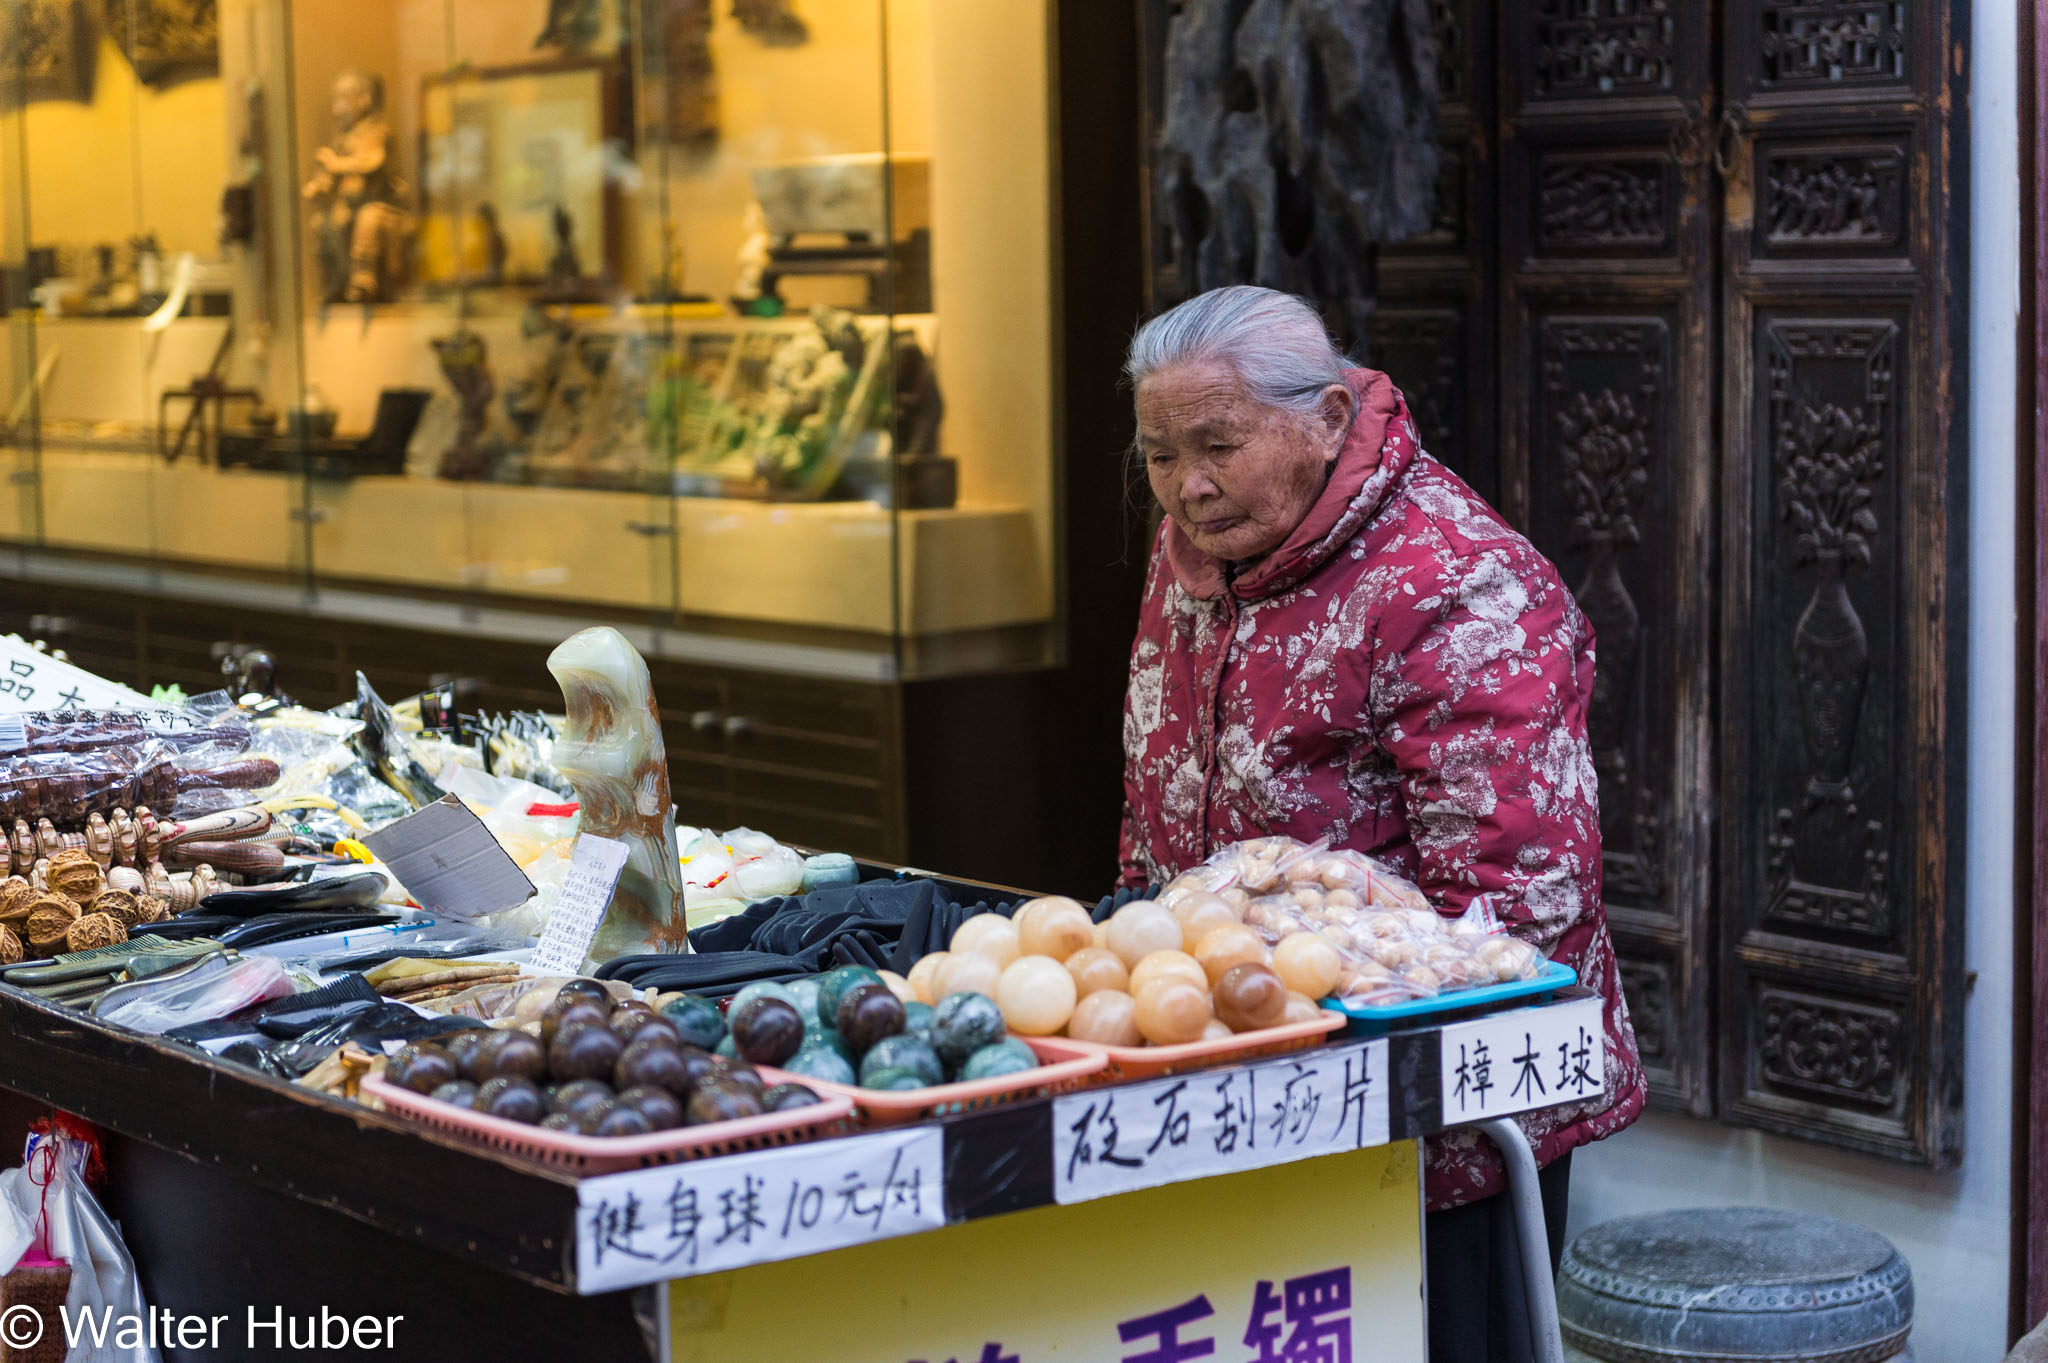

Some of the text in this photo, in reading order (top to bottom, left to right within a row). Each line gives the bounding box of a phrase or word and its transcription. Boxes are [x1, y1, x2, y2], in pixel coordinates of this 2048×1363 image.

[1067, 1046, 1373, 1183] 砭石刮痧片
[1453, 1025, 1601, 1112] 樟木球
